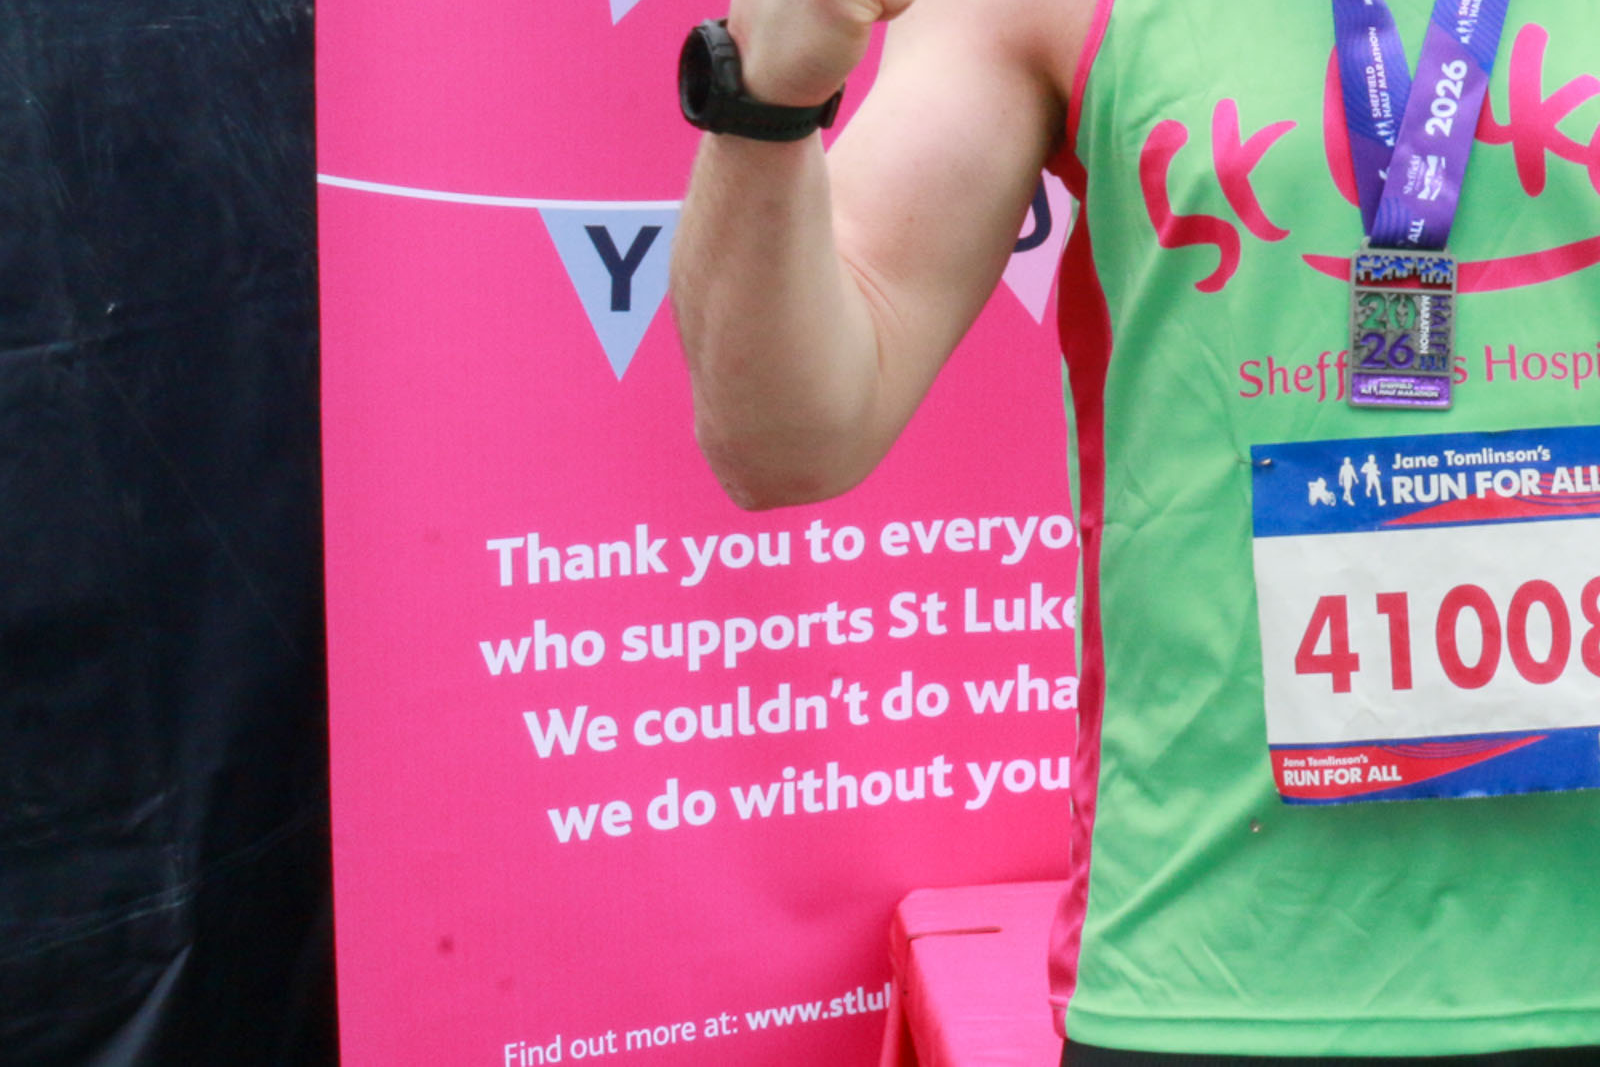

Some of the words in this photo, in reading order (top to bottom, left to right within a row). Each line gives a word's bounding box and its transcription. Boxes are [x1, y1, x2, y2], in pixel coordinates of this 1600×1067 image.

[1368, 27, 1388, 90] MARATHON
[1366, 65, 1382, 118] SHEFFIELD
[1379, 91, 1393, 118] HALF
[1425, 60, 1468, 137] 2026
[1139, 98, 1298, 294] St
[1408, 218, 1425, 244] ALL
[1358, 294, 1417, 329] 20
[1420, 295, 1432, 354] MARATHON
[1360, 332, 1415, 369] 26
[1392, 453, 1439, 469] Jane
[1443, 445, 1551, 466] Tomlinson's
[1392, 472, 1468, 504] RUN
[1475, 468, 1542, 499] FOR
[486, 524, 669, 587] Thank
[680, 532, 791, 587] you
[804, 519, 865, 563] to
[880, 515, 1081, 565] everyo
[479, 619, 606, 676] who
[621, 601, 874, 672] supports
[888, 591, 948, 639] St
[522, 705, 618, 759] We
[633, 678, 869, 746] couldn't
[881, 671, 950, 721] do
[963, 664, 1080, 714] wha
[1283, 757, 1306, 767] Jane
[1307, 753, 1369, 766] Tomlinson's
[1283, 769, 1320, 786] RUN
[1323, 767, 1362, 786] FOR
[1367, 765, 1402, 782] ALL
[547, 800, 633, 843] we
[646, 778, 717, 831] do
[729, 755, 954, 821] without
[965, 757, 1071, 810] you
[504, 1035, 562, 1067] Find
[570, 1030, 618, 1059] out
[626, 1021, 697, 1051] more
[704, 1011, 739, 1038] at:
